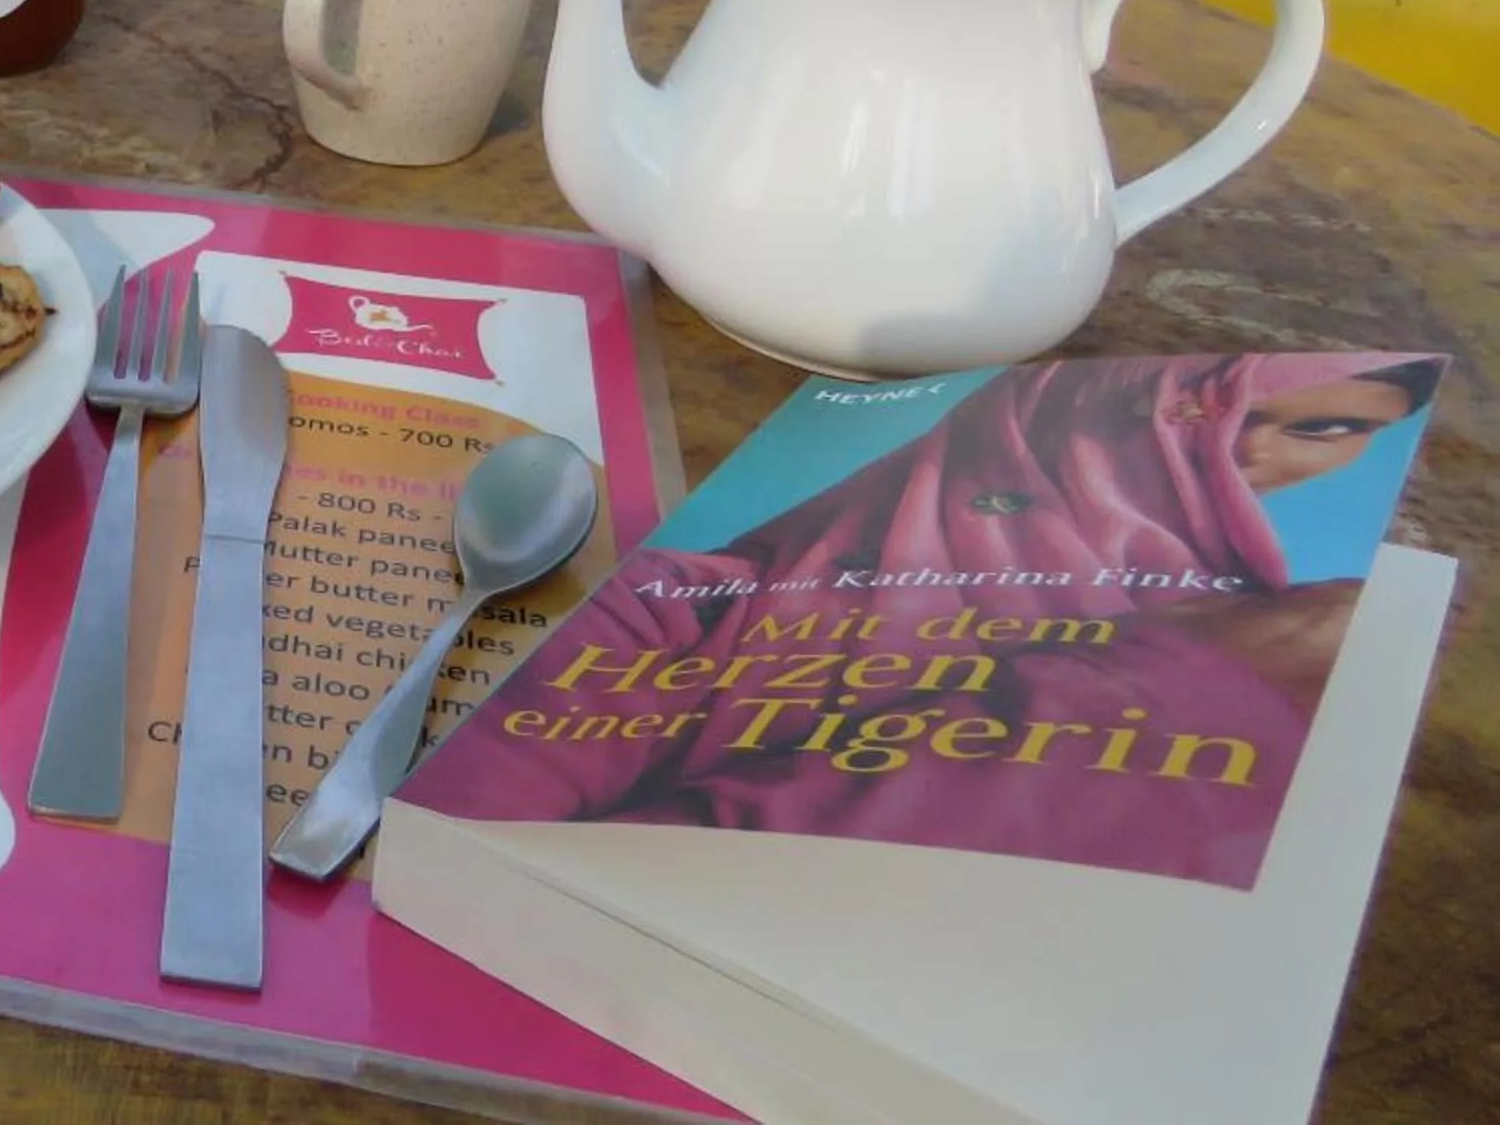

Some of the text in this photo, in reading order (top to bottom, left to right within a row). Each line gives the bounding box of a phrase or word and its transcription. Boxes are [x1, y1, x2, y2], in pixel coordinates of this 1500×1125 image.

[814, 386, 924, 405] HEYNE
[288, 416, 370, 438] omos
[399, 429, 454, 449] 700
[317, 492, 377, 515] 800
[387, 502, 422, 523] Rs
[357, 530, 455, 557] panee
[369, 558, 456, 586] pane
[635, 567, 1245, 599] Amila mit Katharina Finke
[310, 576, 414, 607] butter
[426, 598, 549, 629] msala
[741, 607, 1118, 645] Mit dem
[262, 634, 344, 663] dhai
[543, 641, 996, 694] Herzen
[291, 672, 371, 702] aloo
[266, 704, 333, 731] tter
[503, 706, 708, 742] einer
[722, 693, 1259, 789] Tigerin
